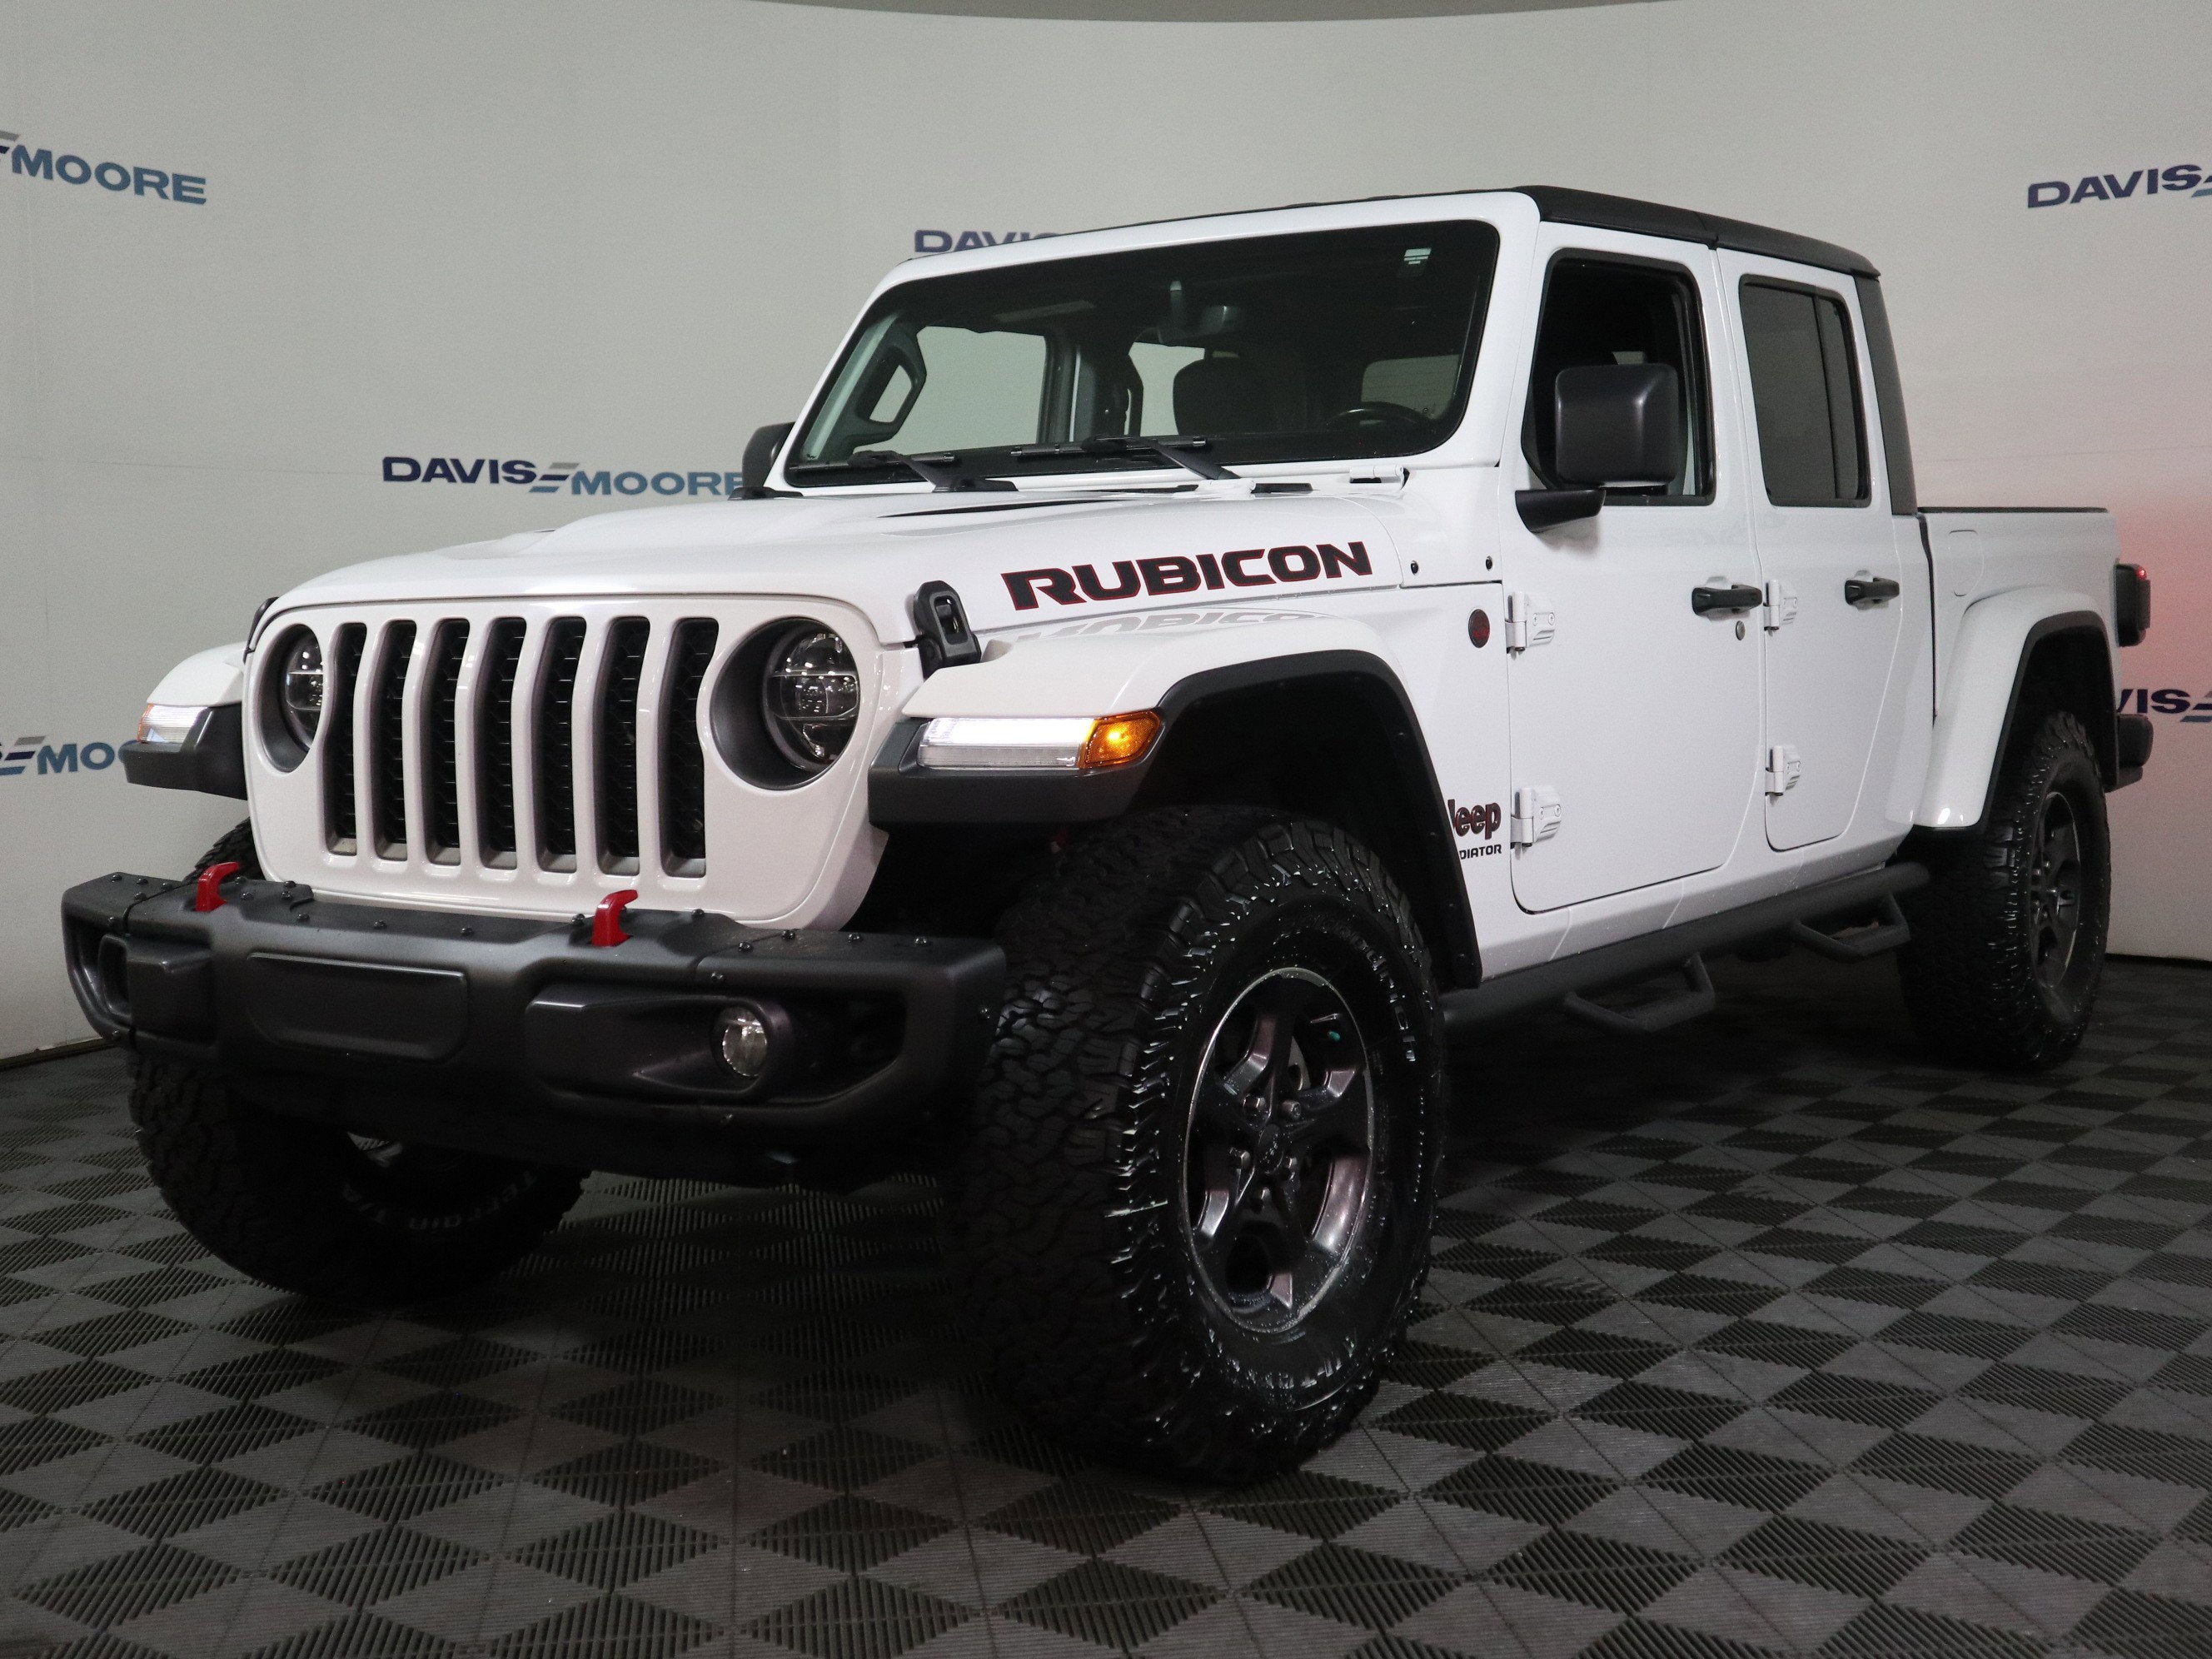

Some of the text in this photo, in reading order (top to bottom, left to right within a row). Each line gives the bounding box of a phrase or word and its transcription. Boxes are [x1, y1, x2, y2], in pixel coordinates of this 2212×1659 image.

[12, 144, 207, 205] MOORE
[2028, 164, 2202, 208] DAVIS
[914, 229, 1062, 252] DAV
[382, 456, 537, 485] DAVIS
[1000, 541, 1373, 611] RUBICON
